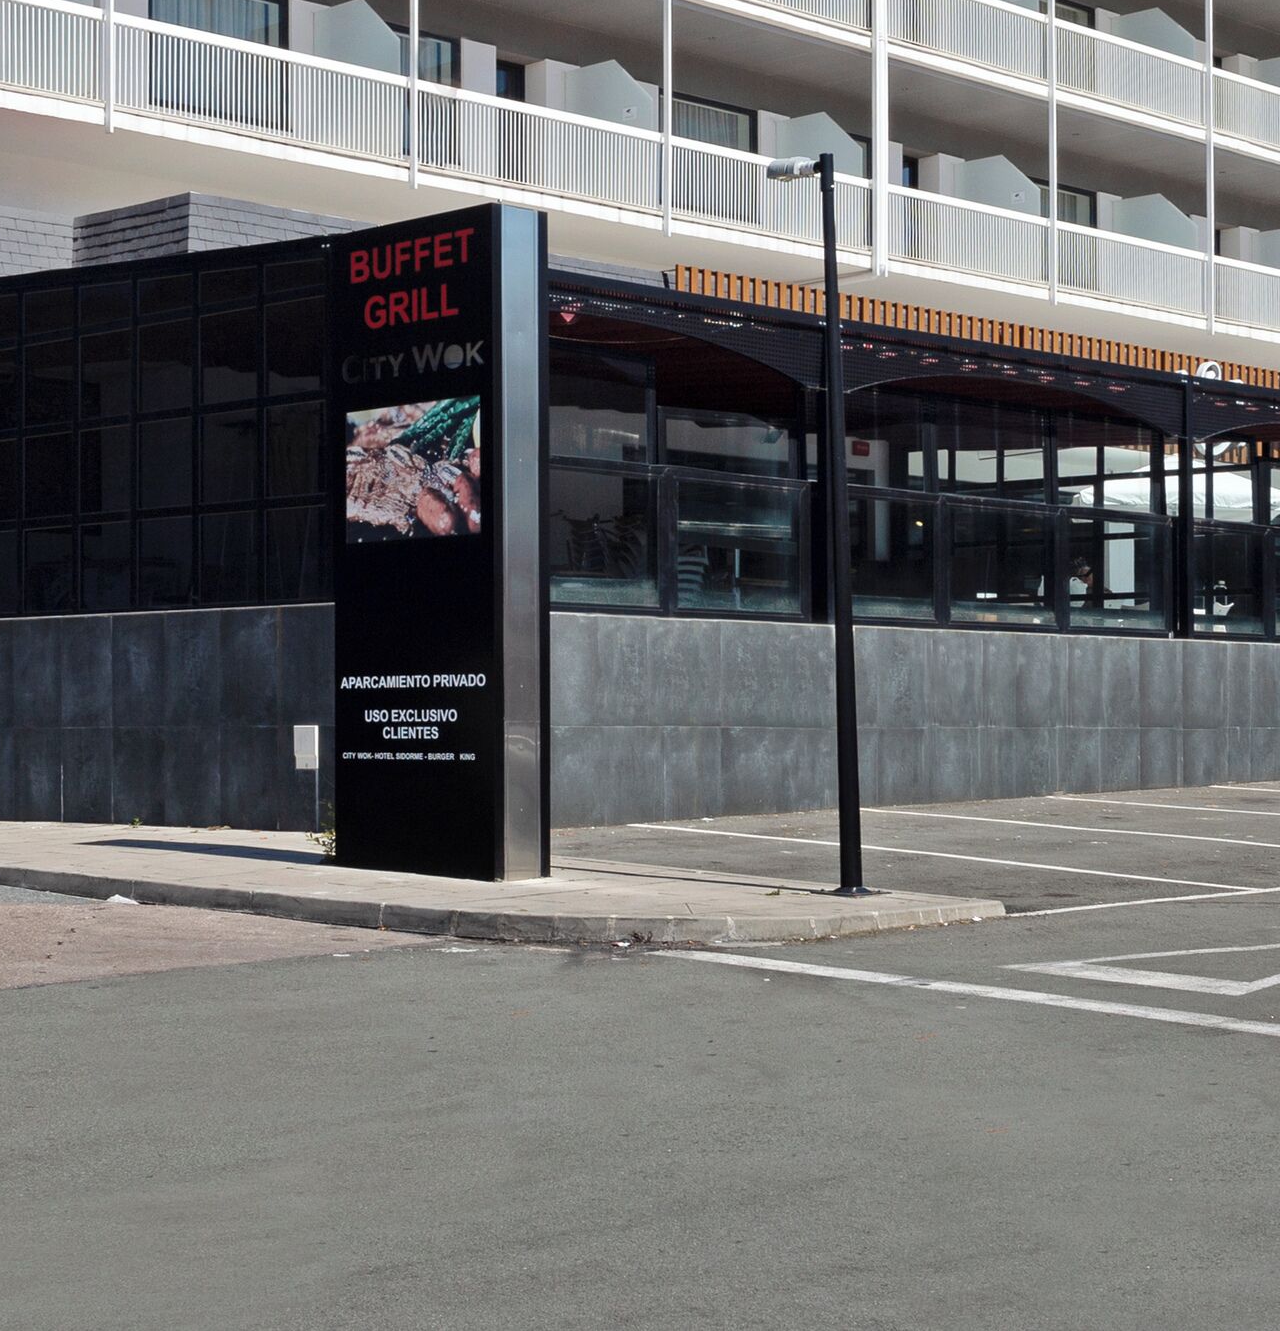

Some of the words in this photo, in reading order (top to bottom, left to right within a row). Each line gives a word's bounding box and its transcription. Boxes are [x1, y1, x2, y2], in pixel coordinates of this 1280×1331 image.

[349, 227, 475, 285] BUFFET
[364, 282, 460, 330] GRILL
[341, 352, 404, 385] CITY
[411, 340, 485, 374] WOK
[340, 674, 431, 689] APARCAMIENTO
[433, 673, 487, 688] PRIVADO
[364, 709, 389, 722] USO
[391, 709, 458, 722] EXCLUSIVO
[382, 726, 440, 740] CLIENTES
[342, 752, 356, 760] CITY
[374, 752, 395, 760] HOTEL
[395, 752, 423, 760] SIDORME
[427, 753, 455, 761] BURGER
[459, 753, 476, 761] KING
